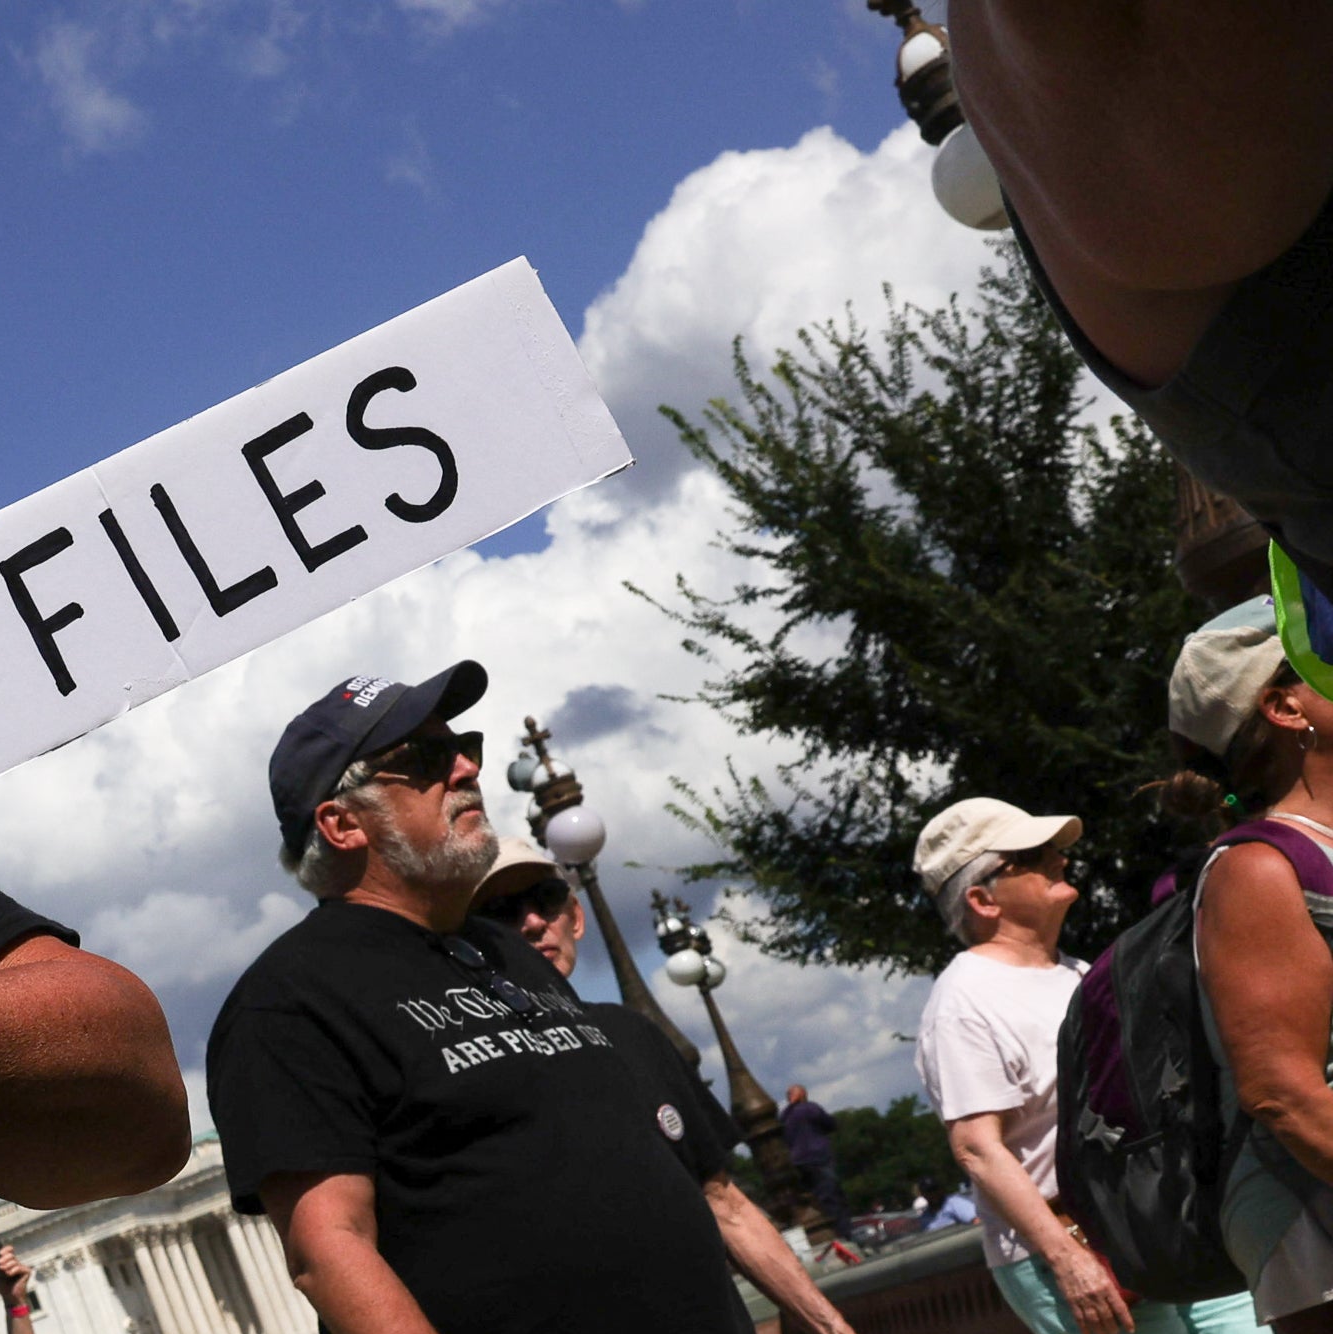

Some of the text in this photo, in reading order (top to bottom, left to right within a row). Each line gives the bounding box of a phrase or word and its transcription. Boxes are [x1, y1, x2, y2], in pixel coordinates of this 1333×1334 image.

[397, 996, 464, 1040] We
[441, 1034, 506, 1074] ARE
[498, 1026, 583, 1056] PISSED
